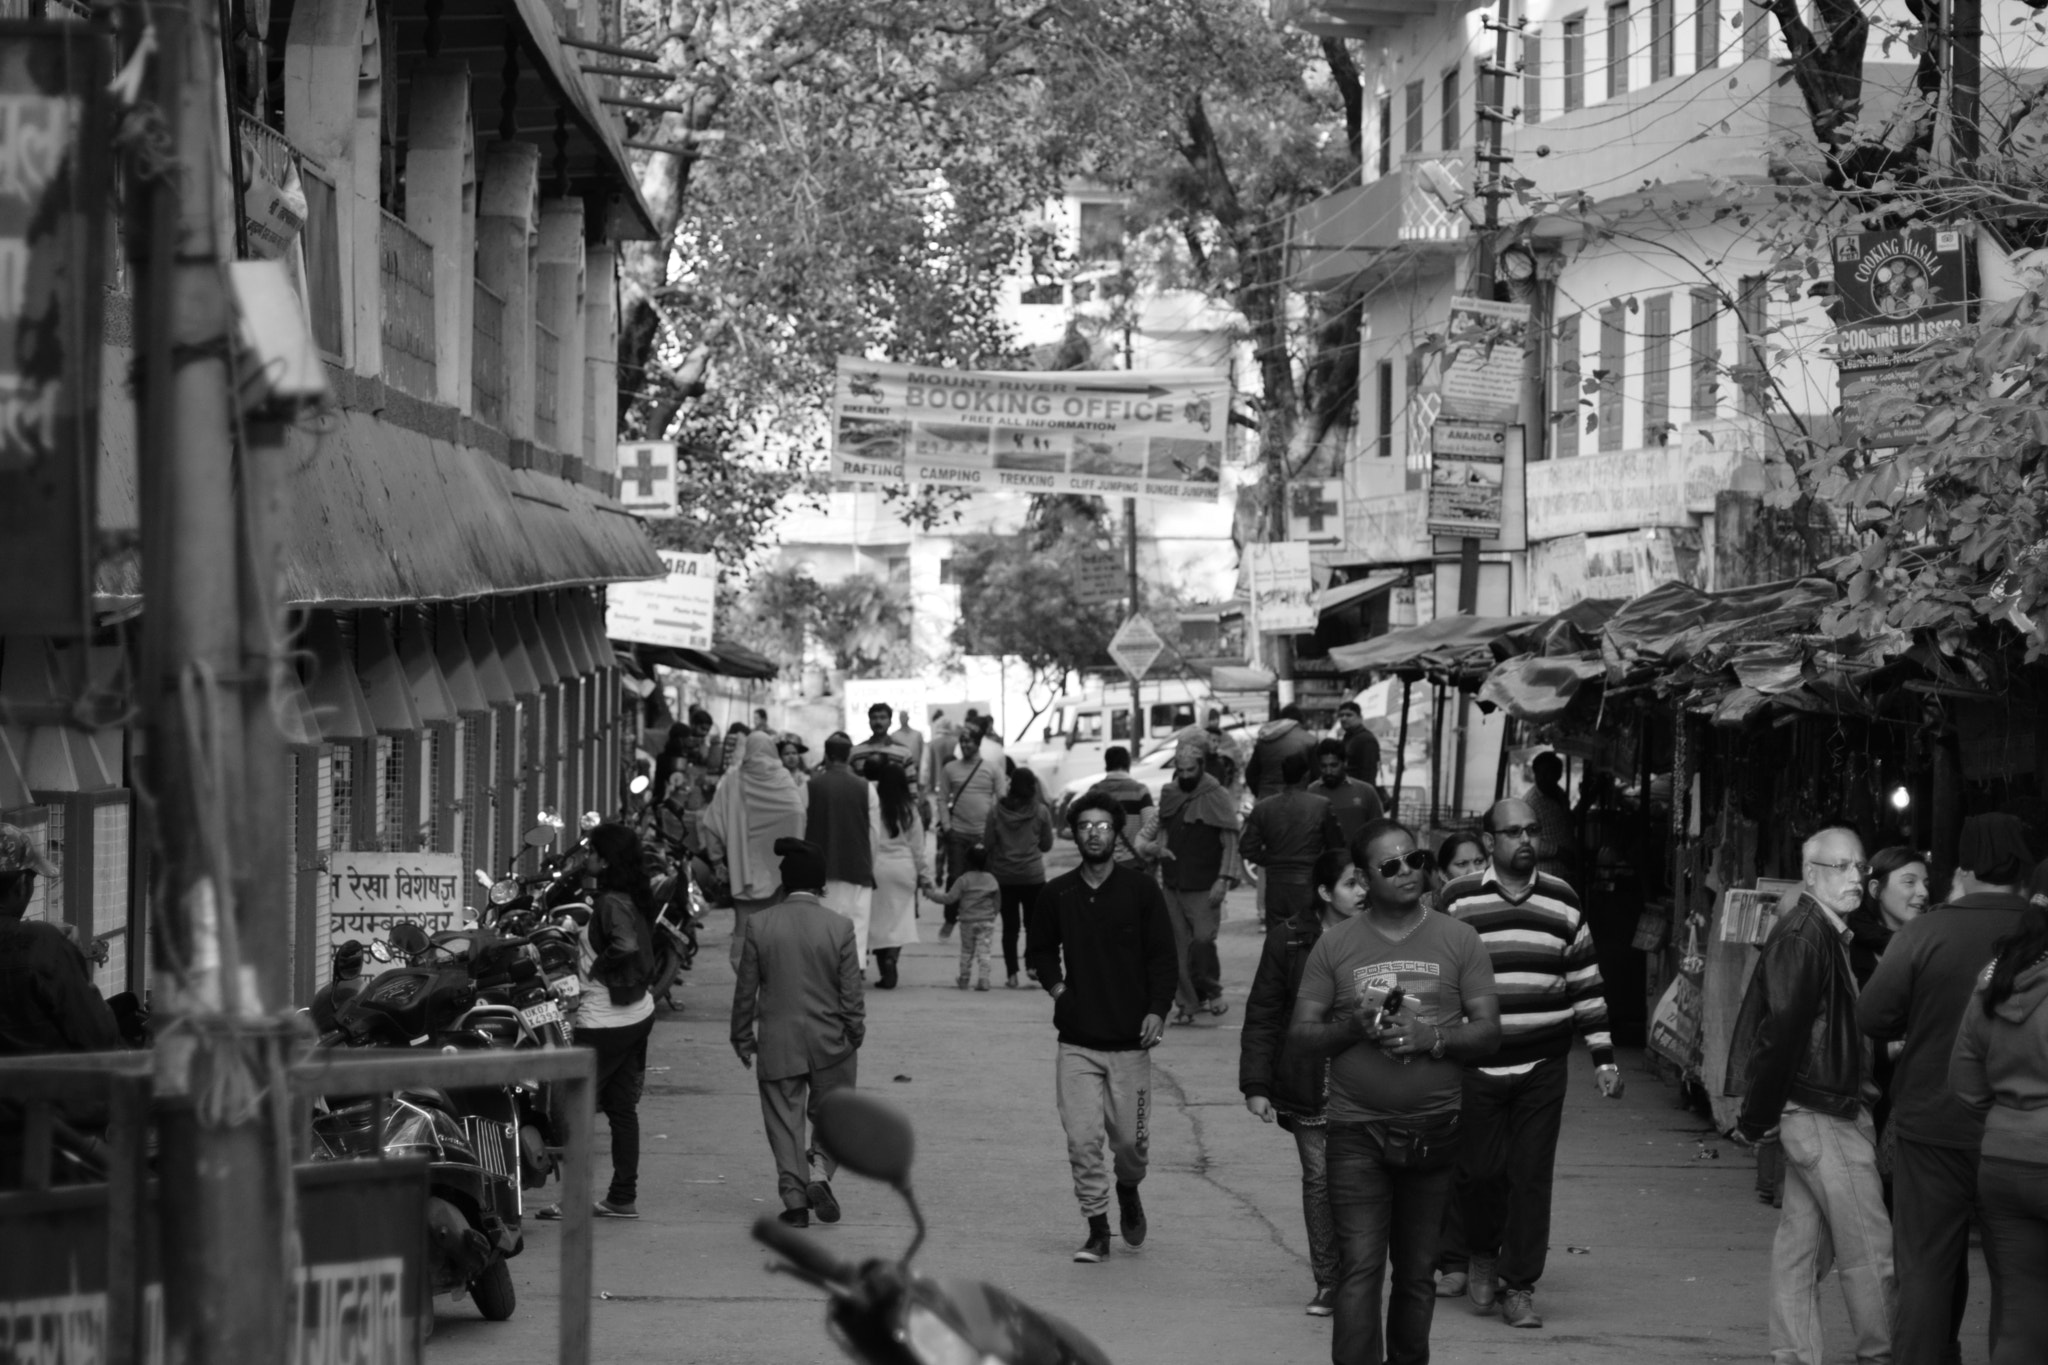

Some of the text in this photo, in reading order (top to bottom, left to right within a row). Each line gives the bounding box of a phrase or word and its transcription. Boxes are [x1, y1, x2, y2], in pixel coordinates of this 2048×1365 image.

[1854, 238, 1943, 283] COOKING MASALA
[1841, 320, 1961, 351] COOKING CLASSES
[907, 372, 1068, 393] MOUNT RIVER
[842, 404, 891, 415] BIKE RENT
[906, 386, 1174, 423] BOOKING OFFICE
[961, 414, 1116, 431] FREE ALL INFORMATION
[1448, 430, 1492, 441] ANANDA
[843, 461, 902, 478] RAFTING
[919, 467, 981, 484] CAMPING
[1000, 472, 1055, 488] TREKKING
[1070, 477, 1139, 493] CLIFF JUMPING
[1146, 484, 1219, 499] BUNGEE JUMPING
[347, 866, 390, 900] रेखा
[1355, 962, 1438, 979] PORSCHE
[524, 1004, 549, 1018] UK07
[1135, 1097, 1146, 1148] adidas
